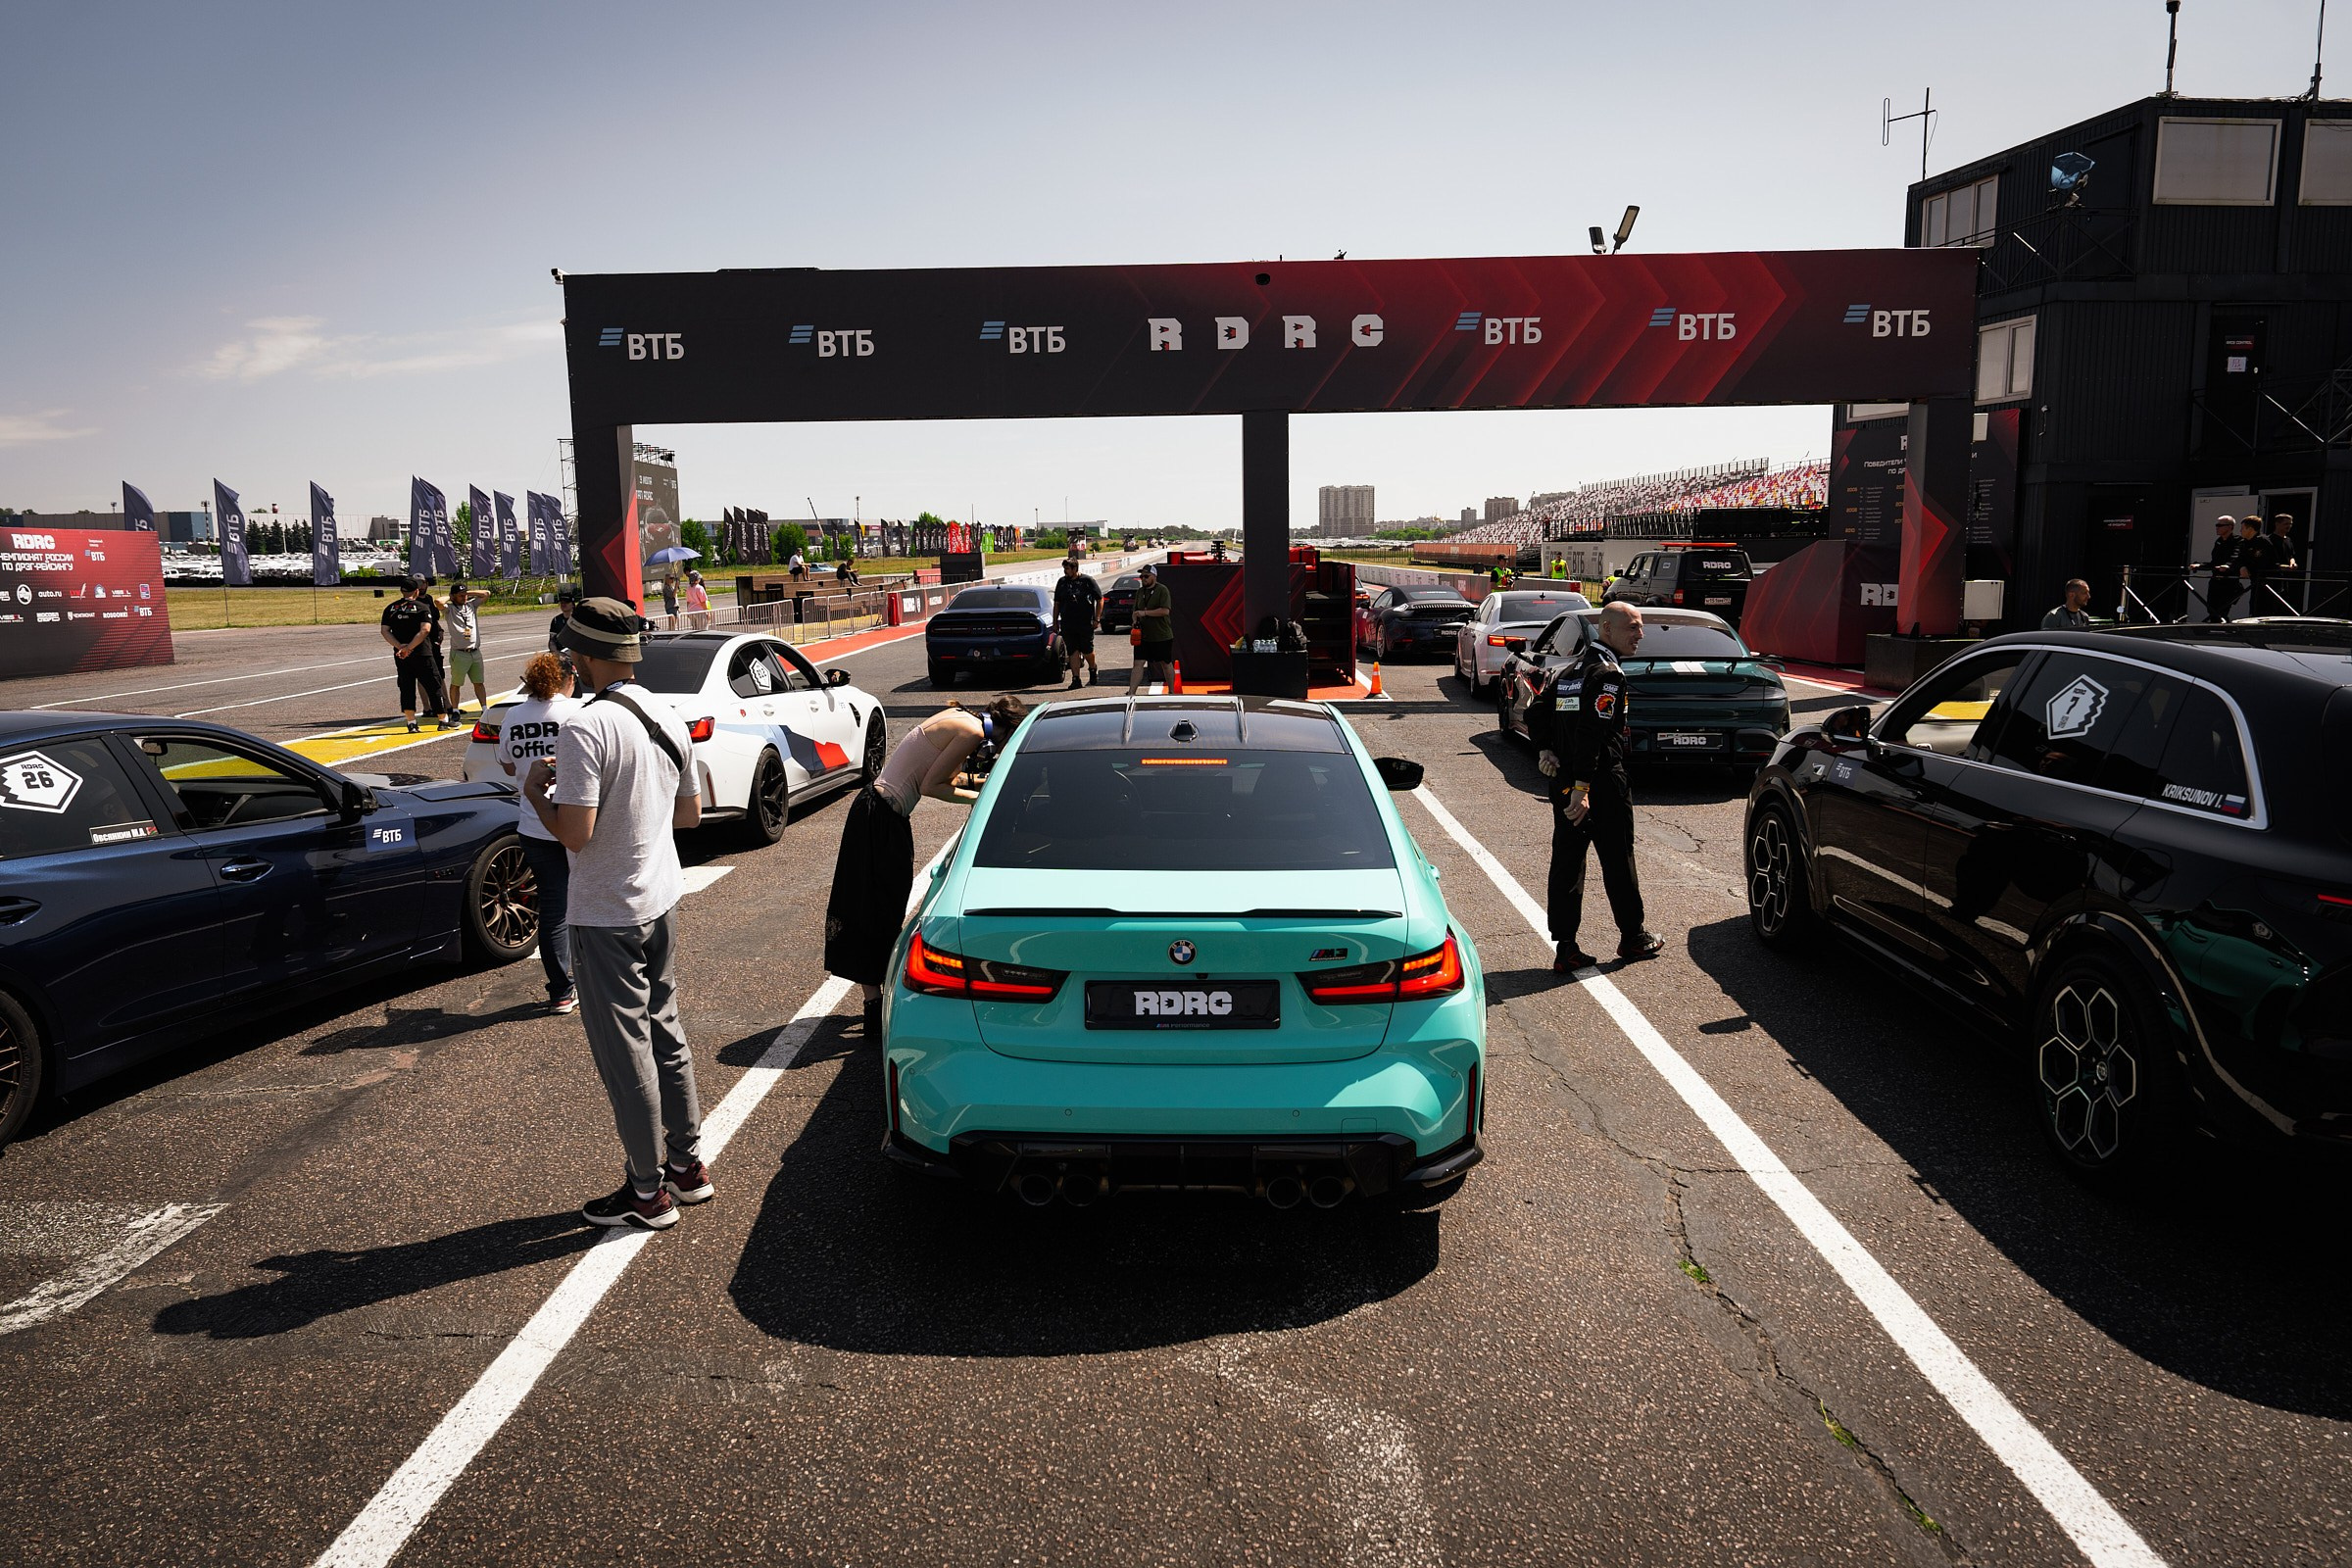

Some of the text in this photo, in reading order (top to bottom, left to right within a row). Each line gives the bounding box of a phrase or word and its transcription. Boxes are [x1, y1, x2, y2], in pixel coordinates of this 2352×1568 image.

[1149, 315, 1383, 350] RDRC
[1486, 318, 1542, 344] ВТБ
[1679, 314, 1736, 340] ВТБ
[1873, 311, 1930, 336] ВТБ
[628, 334, 684, 360] ВТБ
[818, 330, 874, 357] ВТБ
[1009, 326, 1065, 353] ВТБ
[226, 514, 240, 543] ВТБ
[321, 515, 334, 543] ВТБ
[418, 509, 430, 536] ВТБ
[433, 510, 447, 536] ВТБ
[478, 514, 490, 540] ВТБ
[504, 517, 515, 542] ВТБ
[534, 517, 546, 541] ВТБ
[552, 518, 565, 541] ВТБ
[11, 534, 56, 549] RDRC
[16, 562, 74, 571] ДРЭГ-РЕЙСИНГУ
[45, 553, 74, 563] РОССИИ
[91, 551, 105, 562] ВТБ
[1860, 583, 1899, 606] RD
[139, 608, 152, 616] ВТБ
[2066, 697, 2080, 714] 7
[511, 722, 559, 741] RDR
[1674, 736, 1706, 745] RDRC
[512, 742, 556, 759] Offic
[22, 771, 55, 789] 26
[1838, 766, 1852, 778] ВТБ
[2161, 783, 2218, 807] KRIKSUNOV
[382, 828, 402, 844] ВТБ
[1171, 941, 1195, 950] BMW
[1134, 992, 1232, 1015] RDRC
